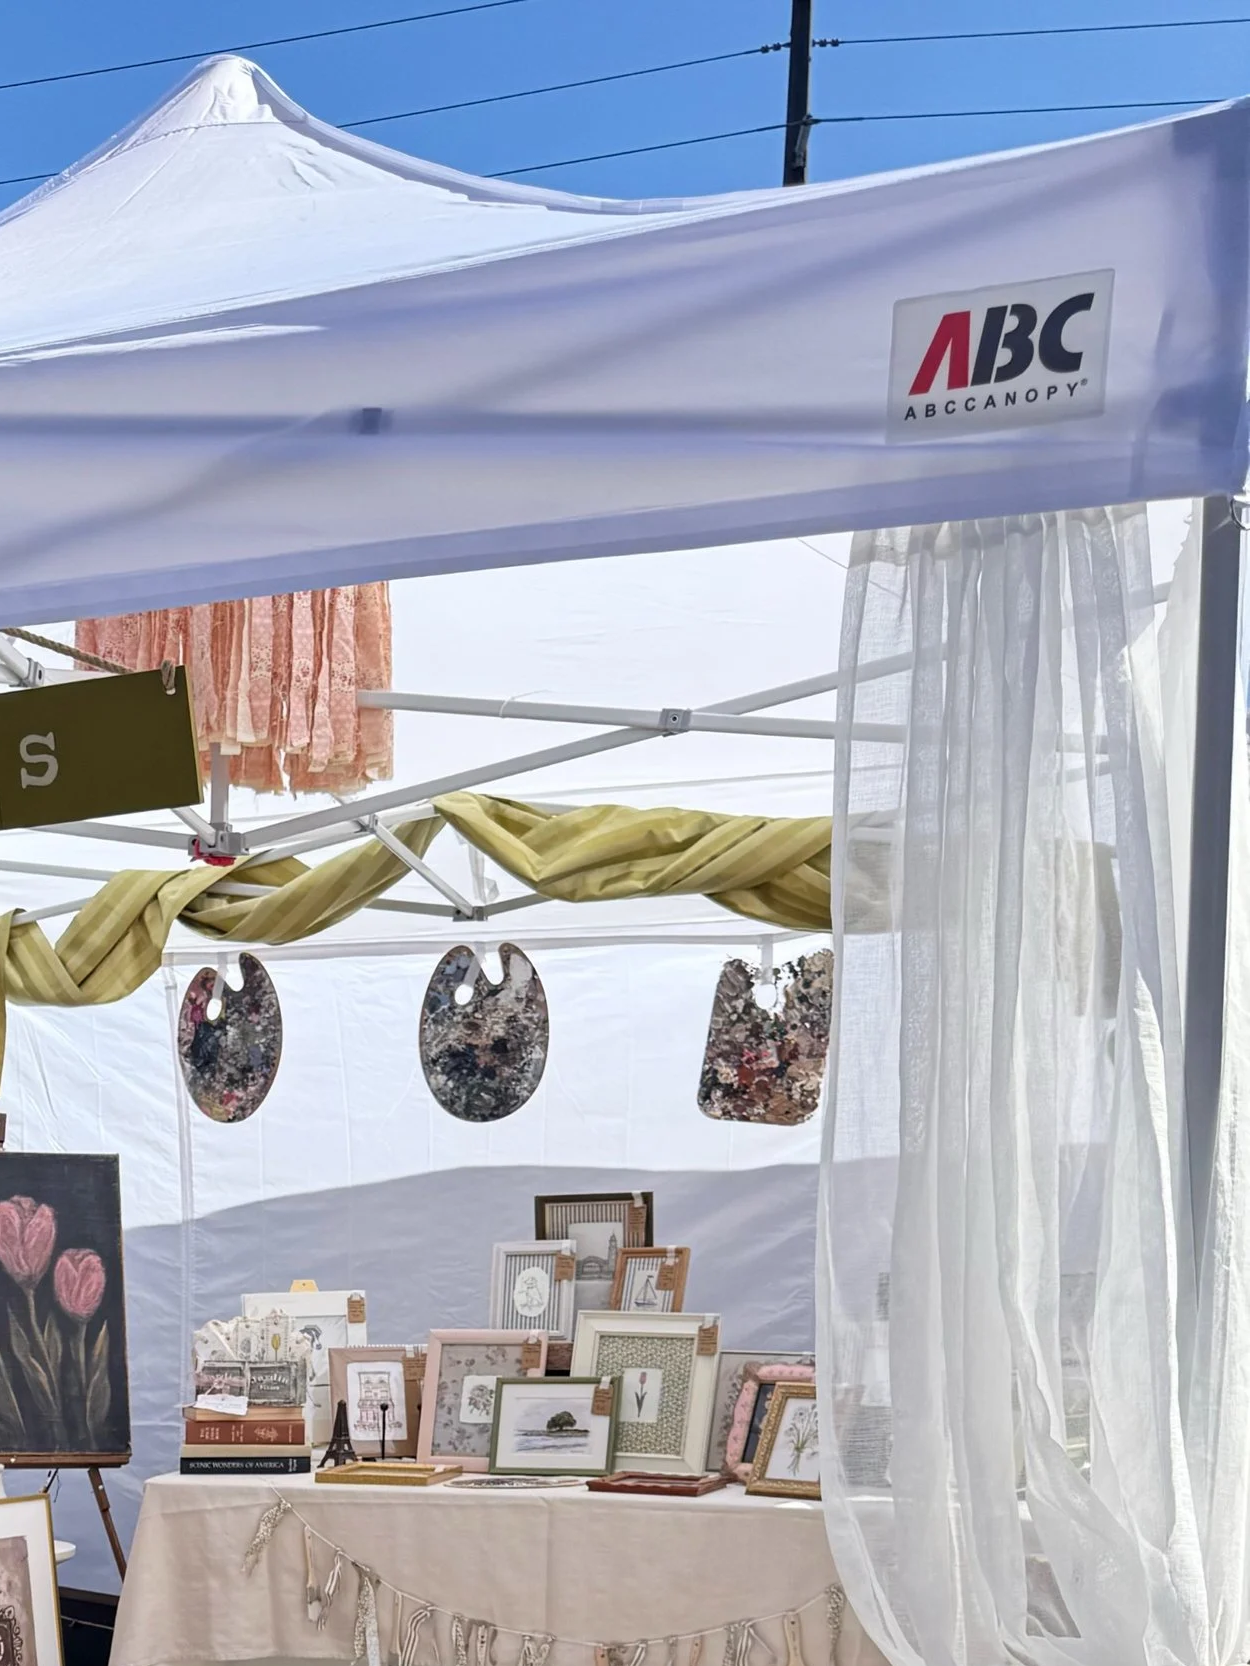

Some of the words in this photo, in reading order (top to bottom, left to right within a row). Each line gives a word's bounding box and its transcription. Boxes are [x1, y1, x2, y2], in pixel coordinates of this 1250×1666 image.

[908, 292, 1095, 396] ABC
[189, 1461, 212, 1469] SCENIC
[212, 1461, 244, 1469] WONDERS
[255, 1461, 284, 1469] AMERICA
